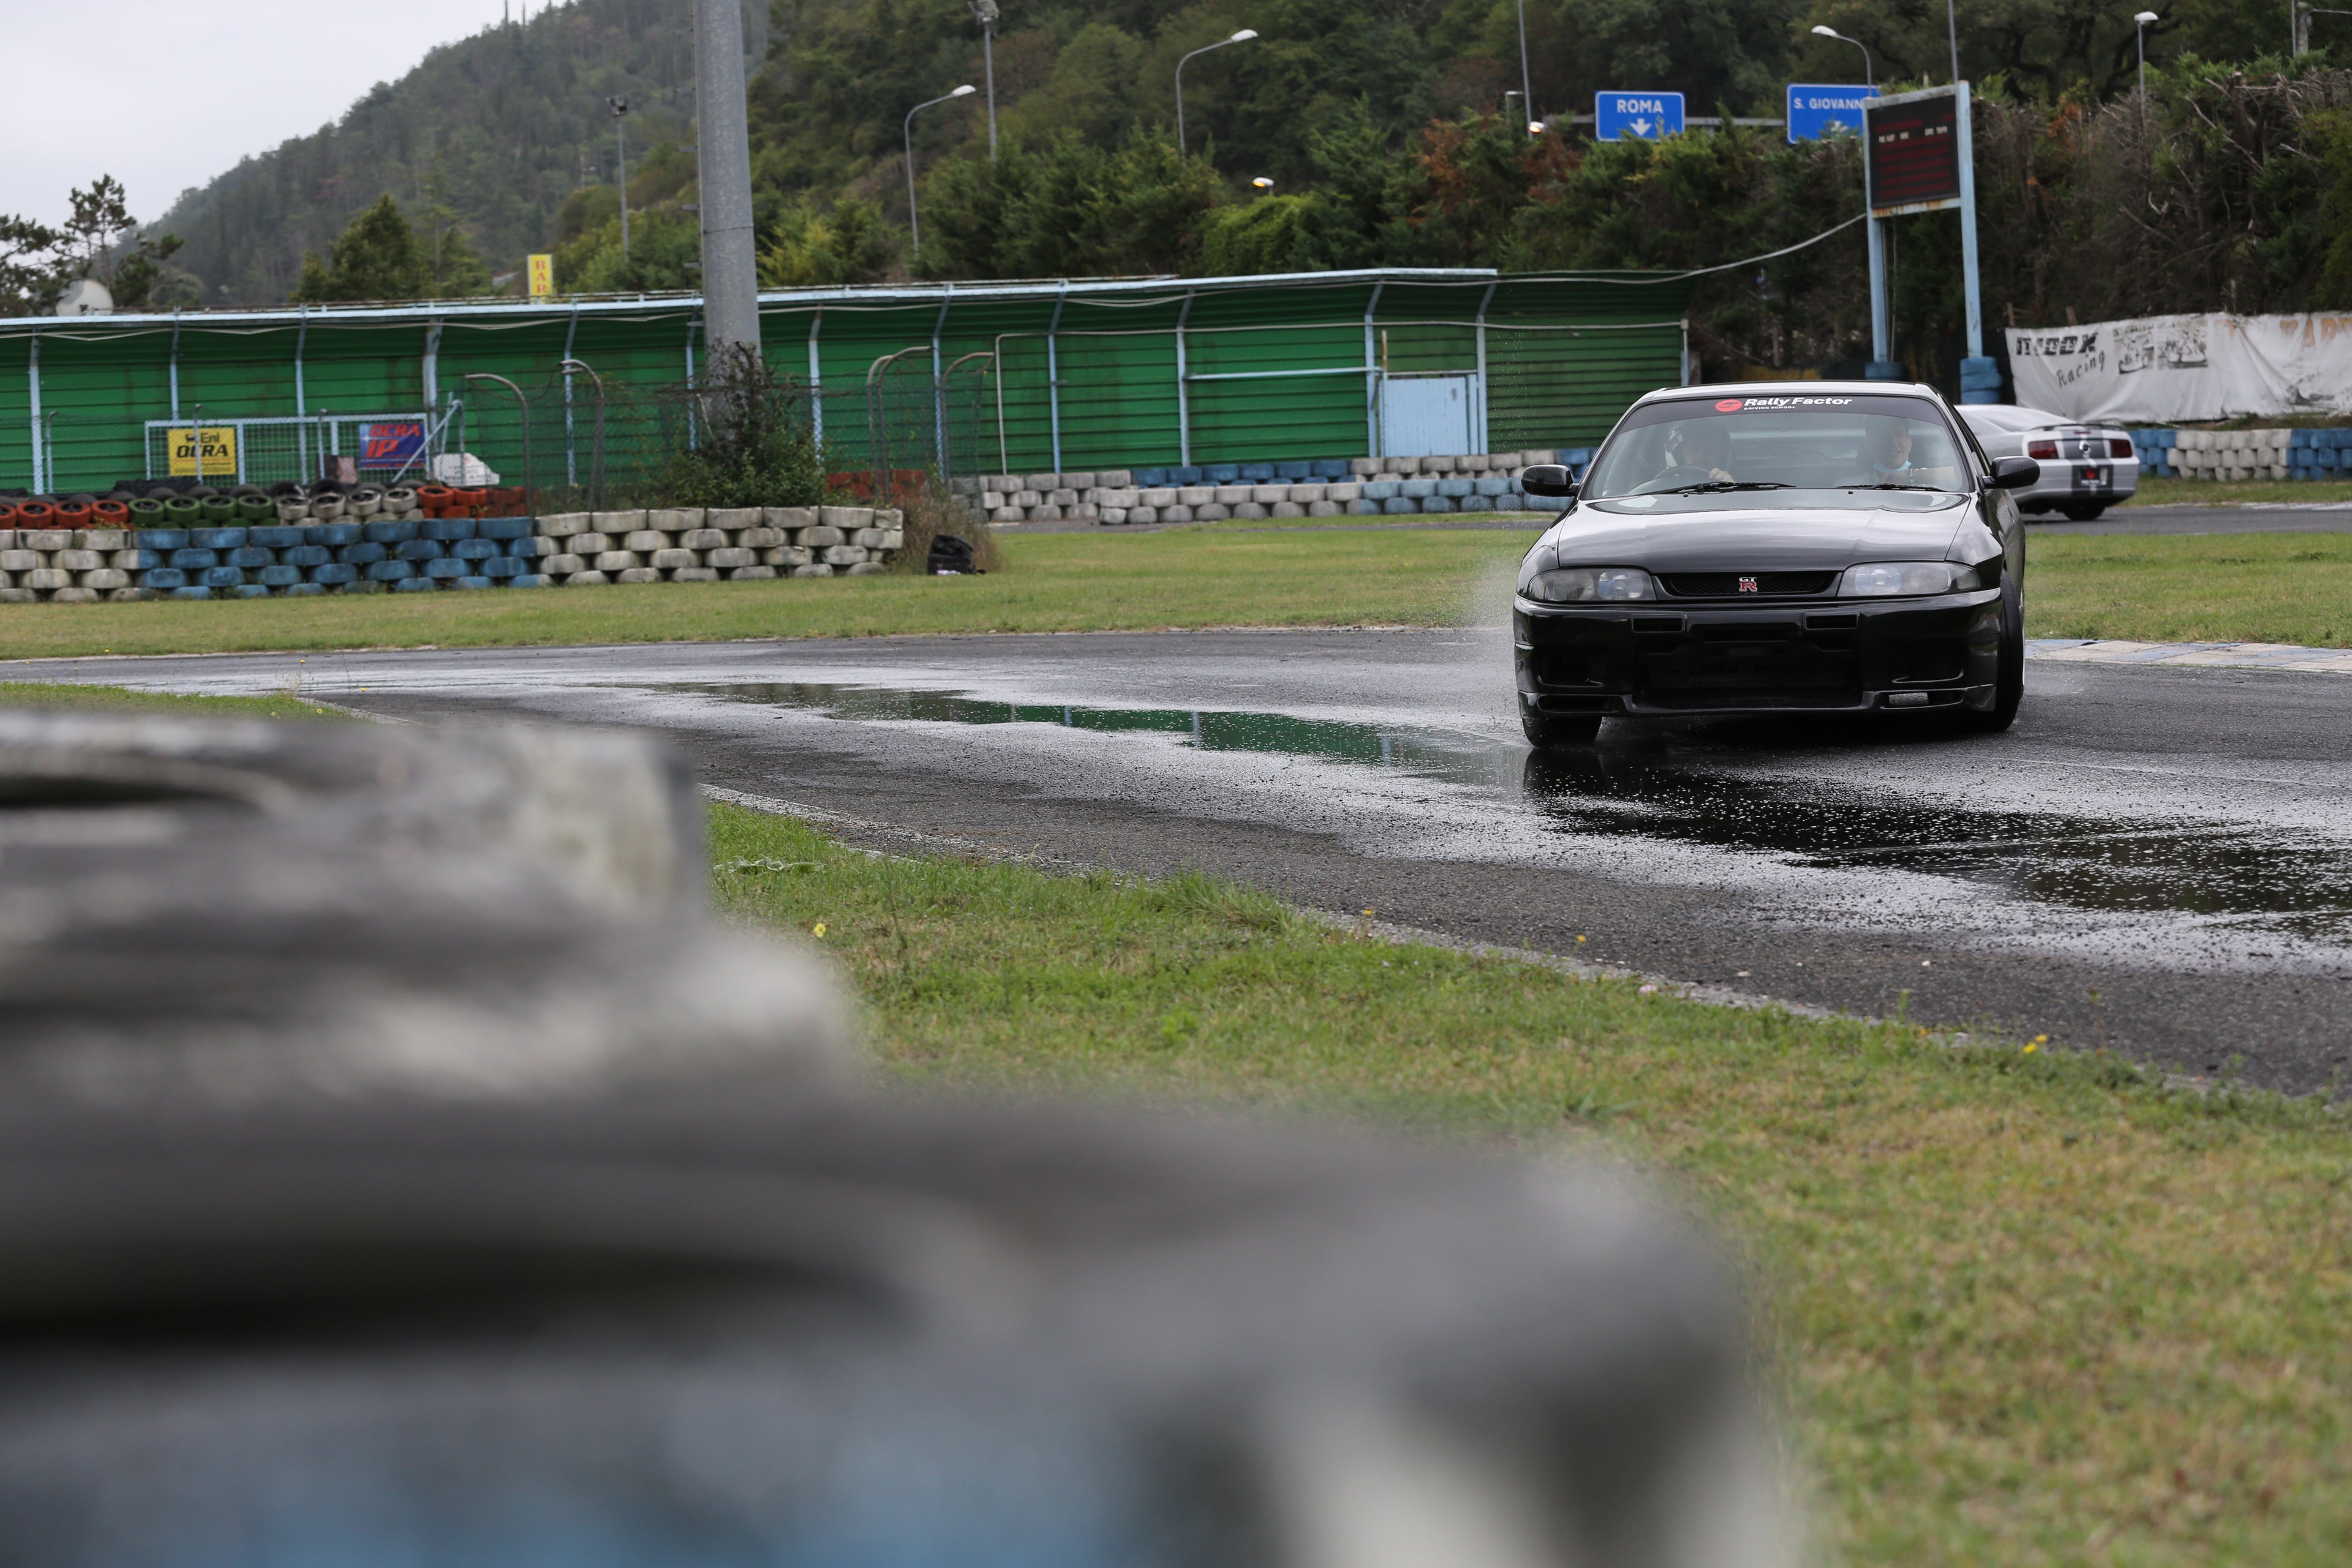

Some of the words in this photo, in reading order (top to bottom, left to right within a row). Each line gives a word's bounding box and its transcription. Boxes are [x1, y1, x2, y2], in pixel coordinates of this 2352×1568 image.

[1616, 99, 1664, 113] ROMA
[1793, 97, 1805, 109] S.
[1809, 98, 1863, 110] GIOVANN
[535, 260, 546, 293] BAR
[2056, 350, 2105, 388] Racing
[1744, 398, 1790, 407] Rally
[370, 424, 421, 437] OCRA
[200, 432, 219, 443] Eni
[365, 439, 399, 458] IP
[1739, 581, 1757, 592] R
